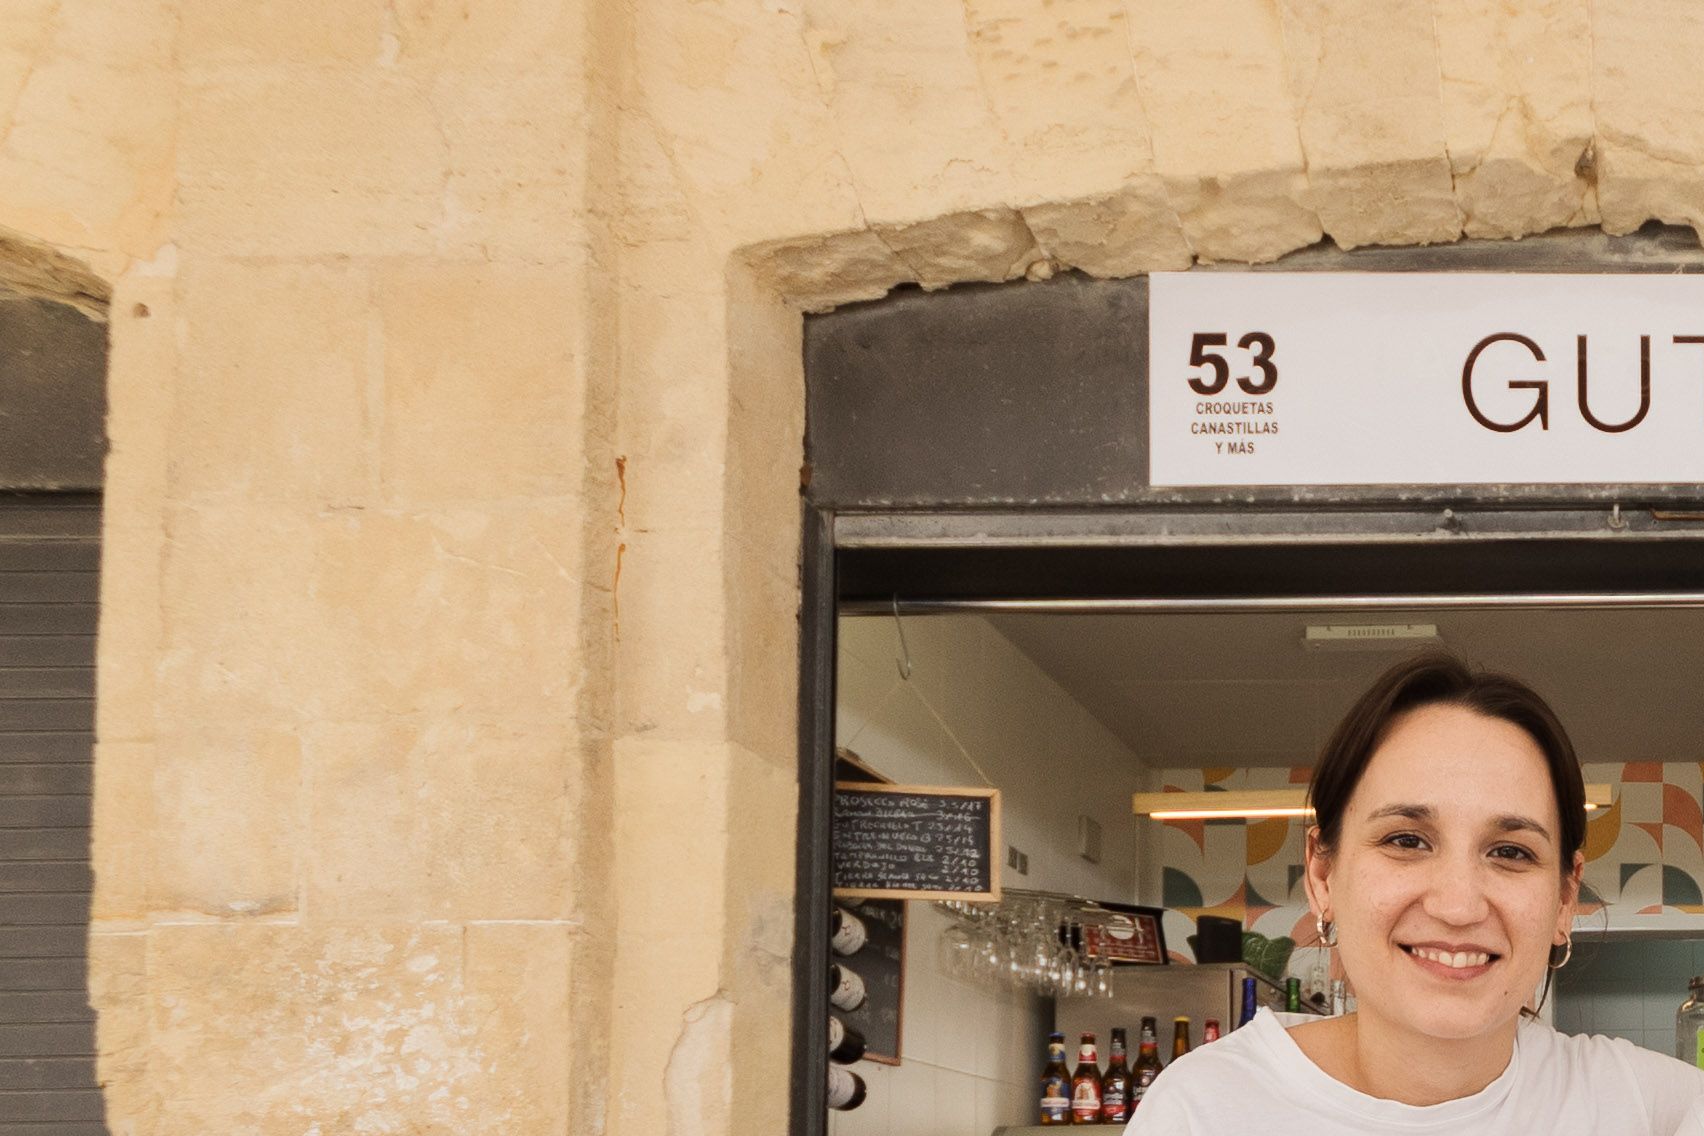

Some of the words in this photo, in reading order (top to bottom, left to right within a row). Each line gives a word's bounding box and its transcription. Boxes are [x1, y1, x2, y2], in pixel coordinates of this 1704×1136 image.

[1187, 331, 1278, 395] 53
[1196, 402, 1274, 415] CROQUETAS
[1191, 422, 1278, 435] CANASTILLAS
[1215, 442, 1223, 454] Y
